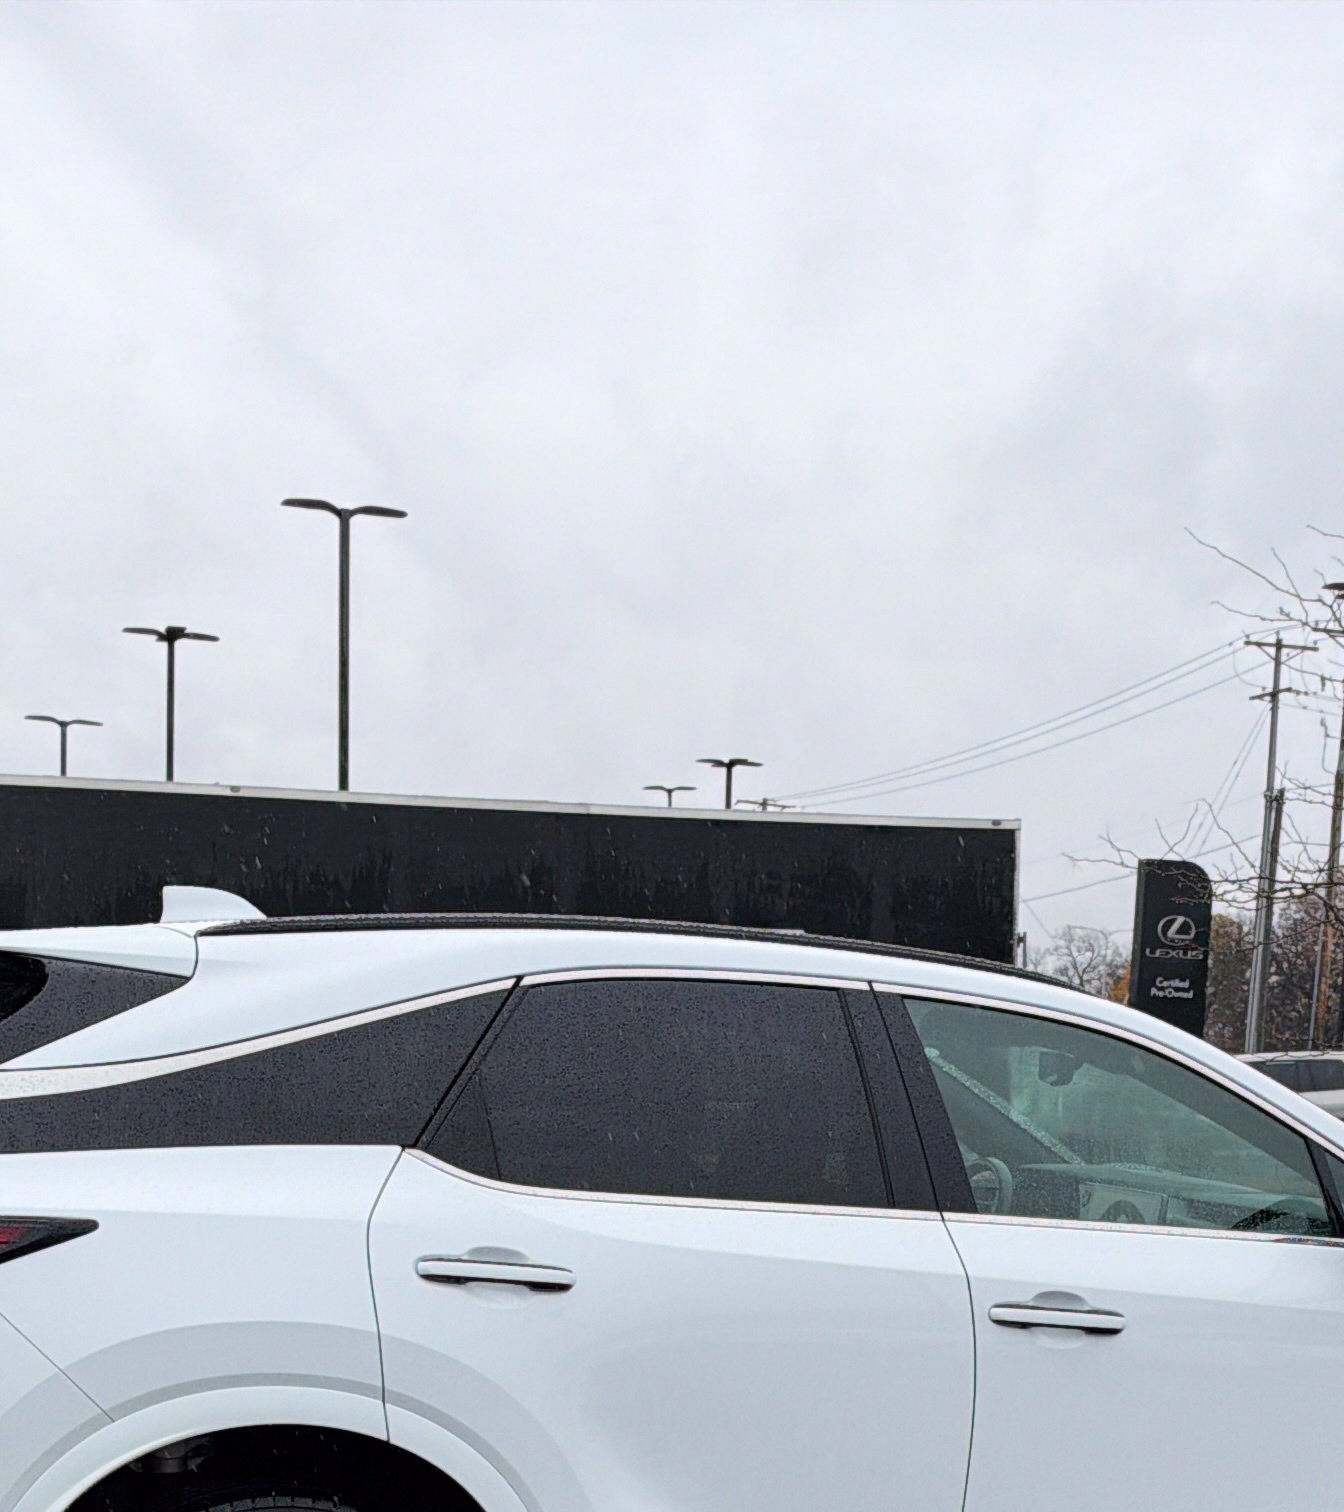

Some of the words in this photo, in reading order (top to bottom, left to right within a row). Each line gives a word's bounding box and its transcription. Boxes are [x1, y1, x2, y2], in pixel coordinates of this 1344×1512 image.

[1145, 947, 1204, 960] LEXUS
[1156, 977, 1190, 989] Certified
[1150, 987, 1194, 999] Pre-Owned
